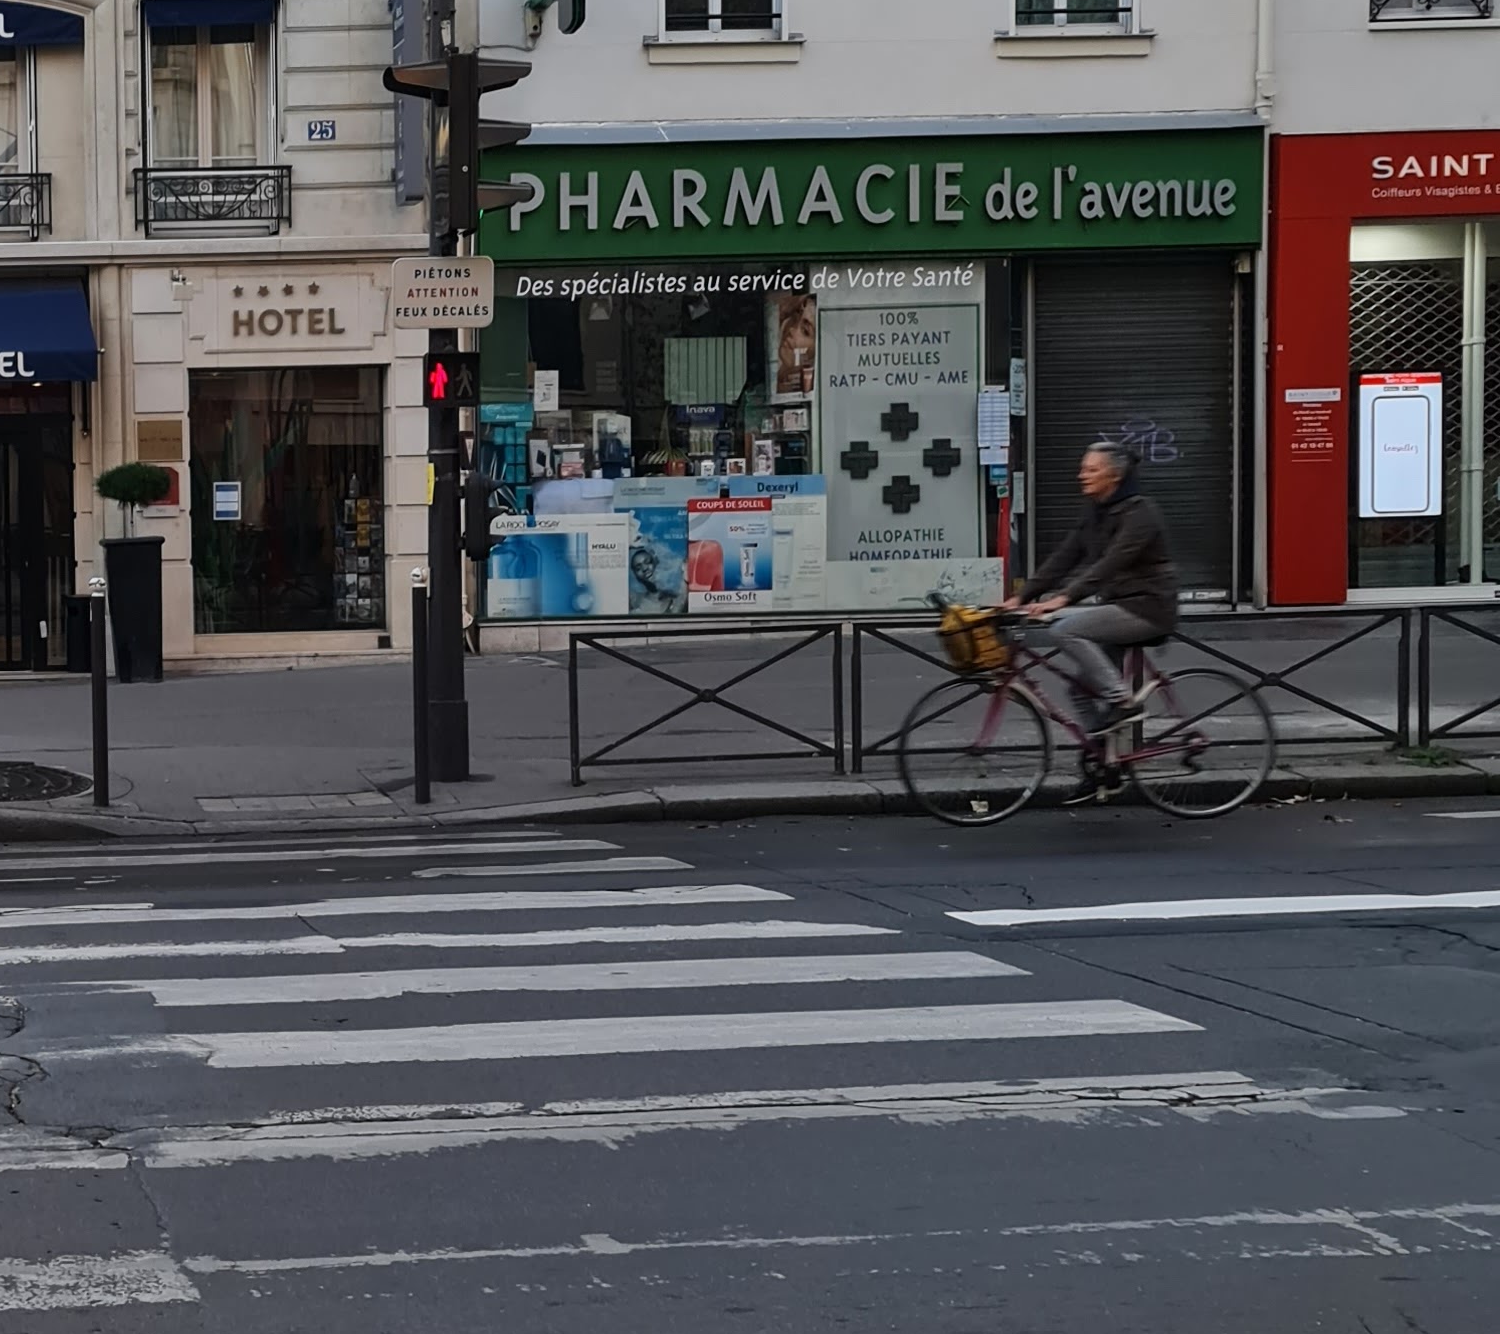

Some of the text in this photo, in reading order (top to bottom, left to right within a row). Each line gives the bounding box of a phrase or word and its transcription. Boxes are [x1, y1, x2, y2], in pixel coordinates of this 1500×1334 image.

[310, 121, 333, 139] 25
[1371, 153, 1495, 179] SAINT
[510, 162, 1238, 231] PHARMACIE de l'avenue
[1371, 187, 1422, 199] Coiffeurs
[1424, 185, 1481, 198] Visagistes
[1484, 183, 1492, 195] &
[414, 267, 471, 279] PIÉTONS
[516, 263, 974, 302] Des spécialistes au service de Votre Santé
[407, 287, 479, 298] ATTENTION
[396, 304, 489, 317] FEUX DÉCALÉS
[879, 311, 919, 326] 100%
[232, 307, 346, 337] HOTEL
[847, 330, 951, 347] TIERS PAYANT
[858, 351, 941, 367] MUTUELLES
[829, 373, 867, 388] RATP
[885, 372, 918, 386] CMU
[937, 370, 969, 384] AME
[686, 405, 716, 414] Inava
[757, 481, 799, 494] Dexeryl
[696, 500, 765, 509] COUPS DE SOLEIL
[857, 528, 945, 544] ALLOPATHIE
[704, 591, 757, 602] Osmo Soft
